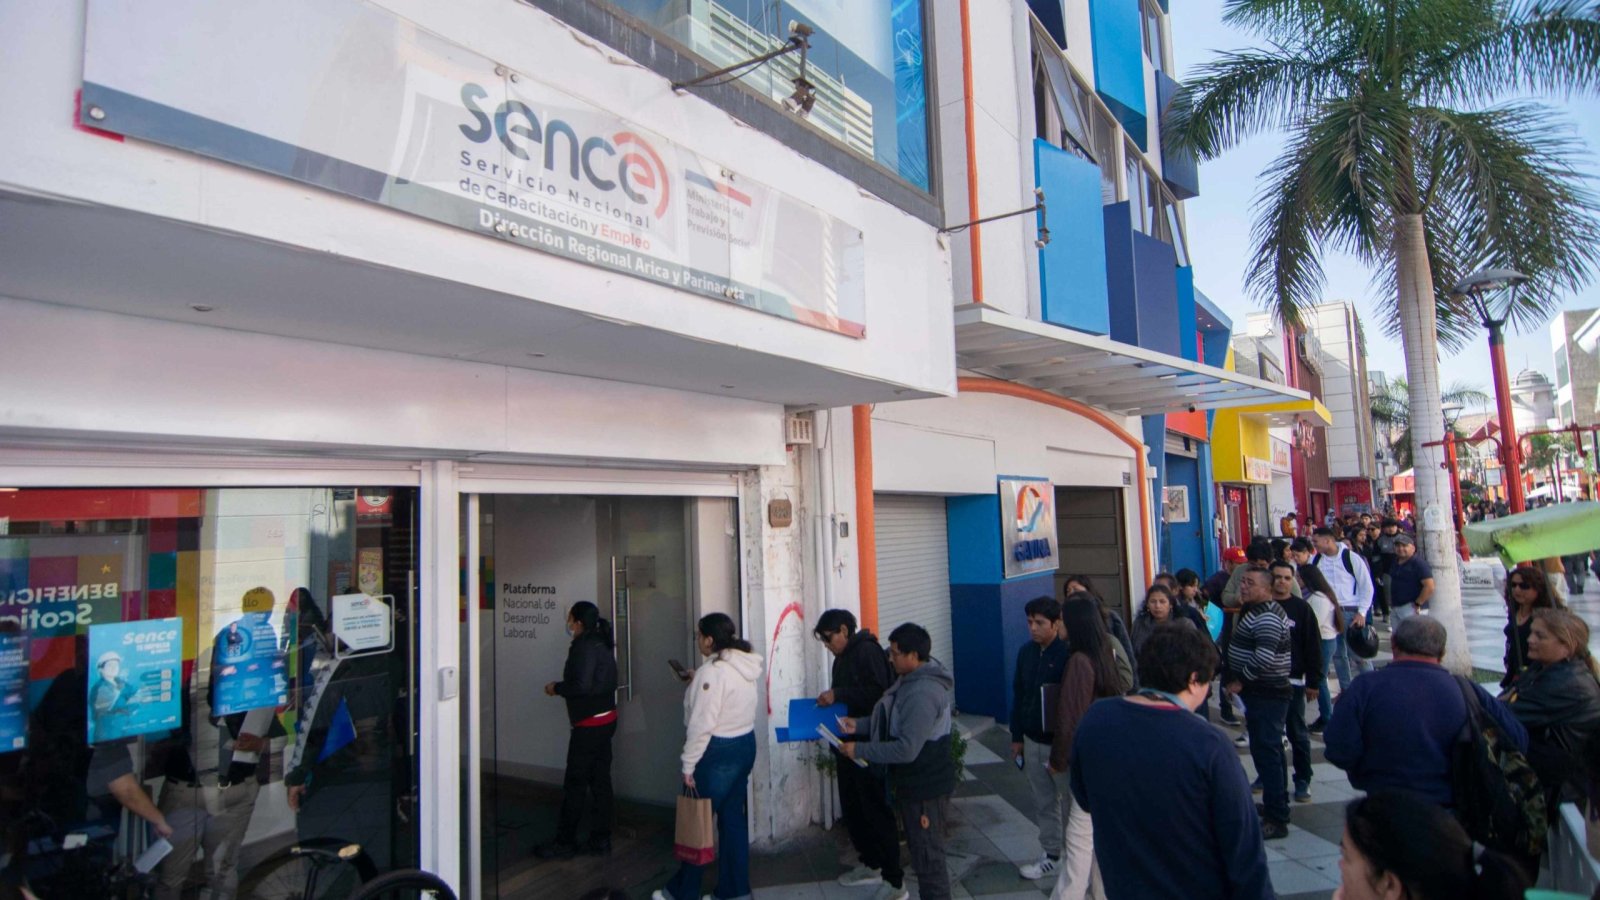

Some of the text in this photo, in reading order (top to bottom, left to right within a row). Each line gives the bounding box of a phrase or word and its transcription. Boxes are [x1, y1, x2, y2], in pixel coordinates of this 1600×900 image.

[459, 150, 649, 229] Servicio Nacional
[459, 177, 650, 250] de Capacitación y Empleo
[687, 188, 744, 219] Ministerio del
[687, 203, 719, 224] Trabajo
[687, 219, 751, 247] Previsión Social
[479, 208, 564, 249] Dirección
[568, 236, 632, 270] Regional
[631, 256, 670, 279] Arica
[671, 270, 681, 285] y
[503, 583, 556, 595] Plataforma
[503, 598, 556, 609] Nacional de
[503, 612, 549, 624] Desarrollo
[503, 627, 537, 639] Laboral
